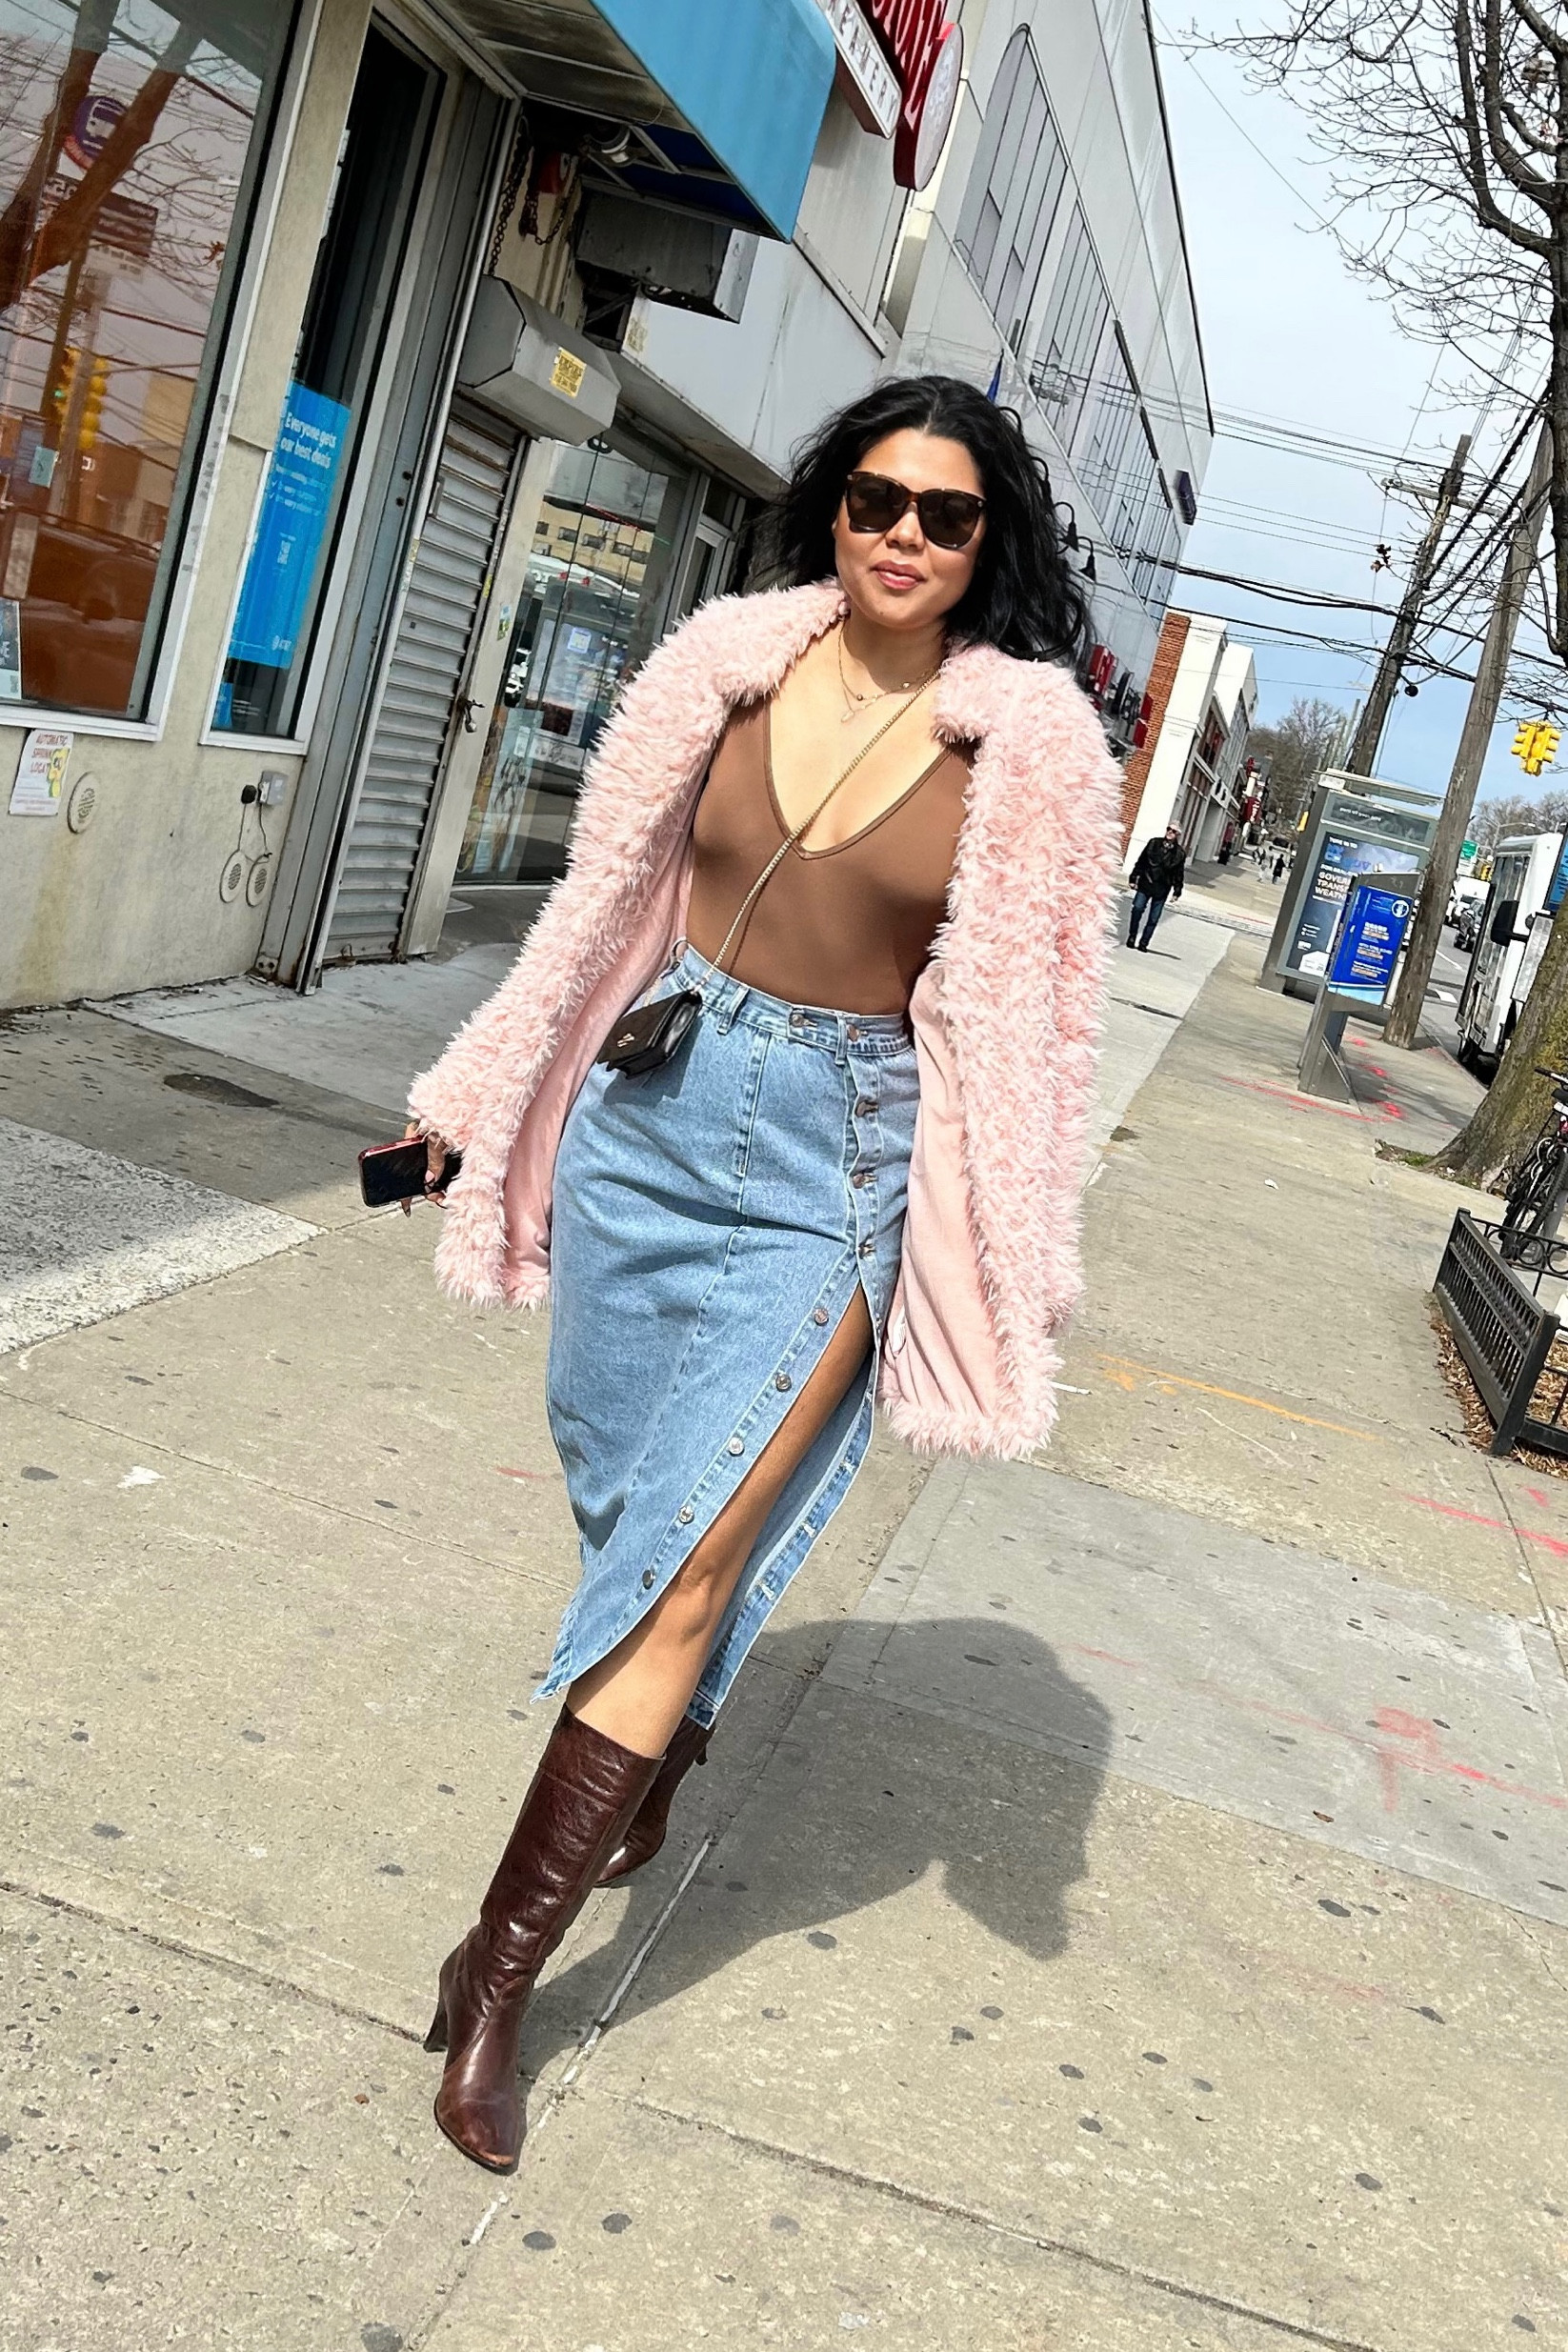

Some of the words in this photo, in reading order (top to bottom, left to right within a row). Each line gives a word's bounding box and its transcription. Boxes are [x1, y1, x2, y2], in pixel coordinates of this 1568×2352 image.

[285, 412, 320, 440] Everyone
[319, 431, 337, 448] gets
[280, 437, 294, 452] our
[293, 438, 312, 461] best
[1317, 878, 1350, 893] TRANS
[1318, 872, 1351, 886] GOVER
[1315, 886, 1347, 901] WEATH
